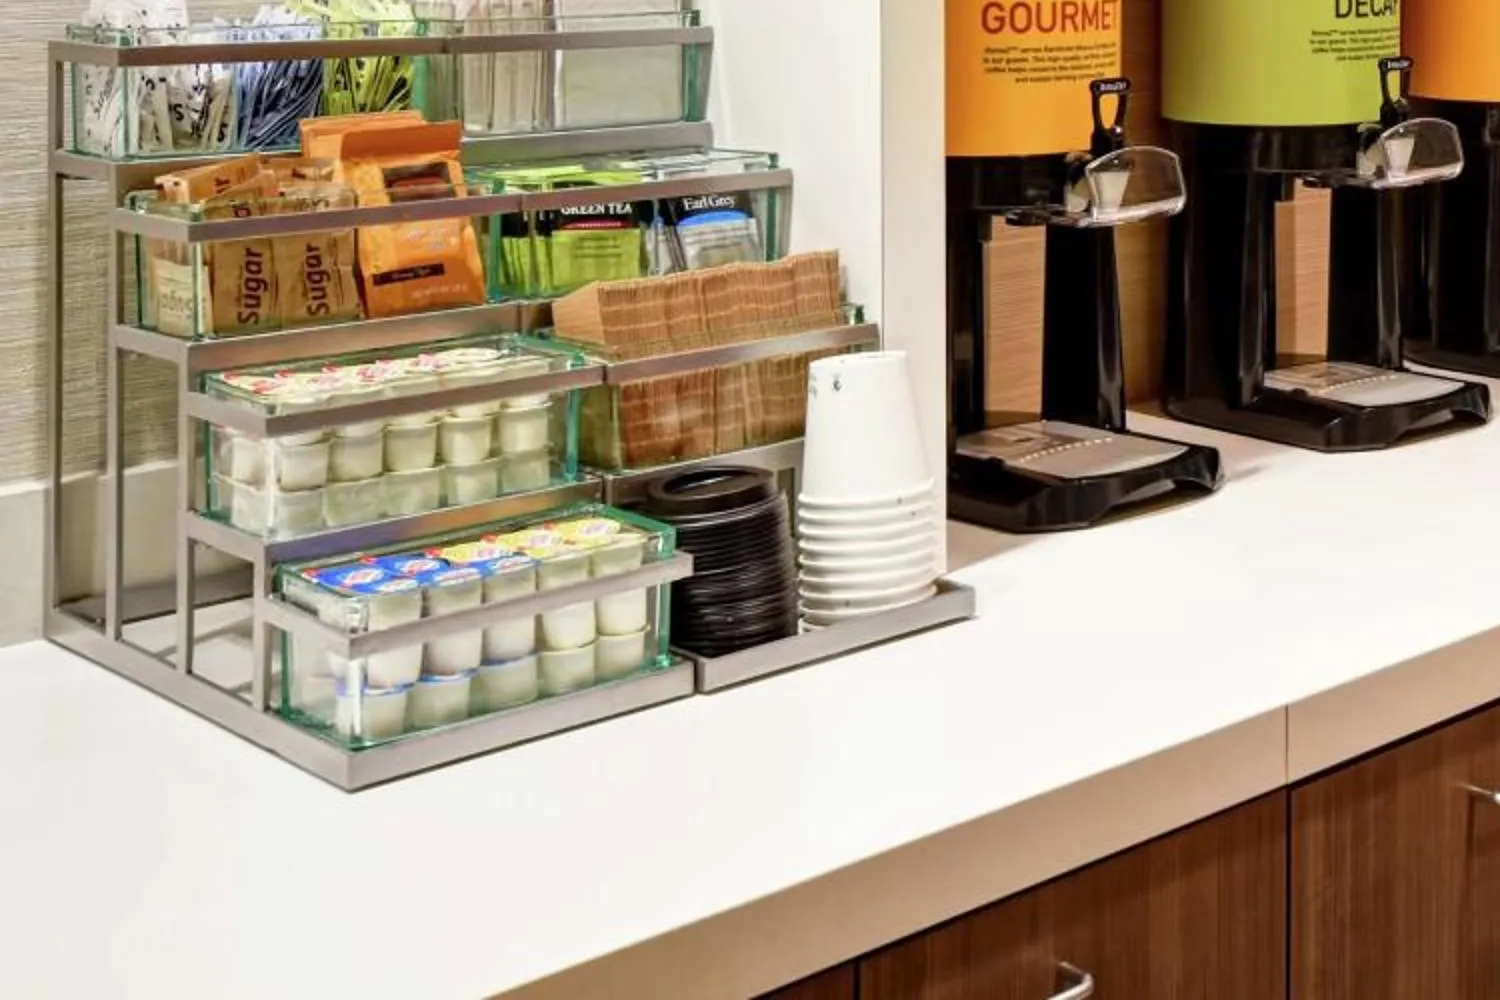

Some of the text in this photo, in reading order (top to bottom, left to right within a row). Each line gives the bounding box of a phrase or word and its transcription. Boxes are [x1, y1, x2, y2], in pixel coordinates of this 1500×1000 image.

[561, 202, 633, 215] GREEN TEA
[682, 194, 736, 210] Earl Grey
[237, 247, 268, 325] Sugar
[306, 244, 331, 316] Sugar
